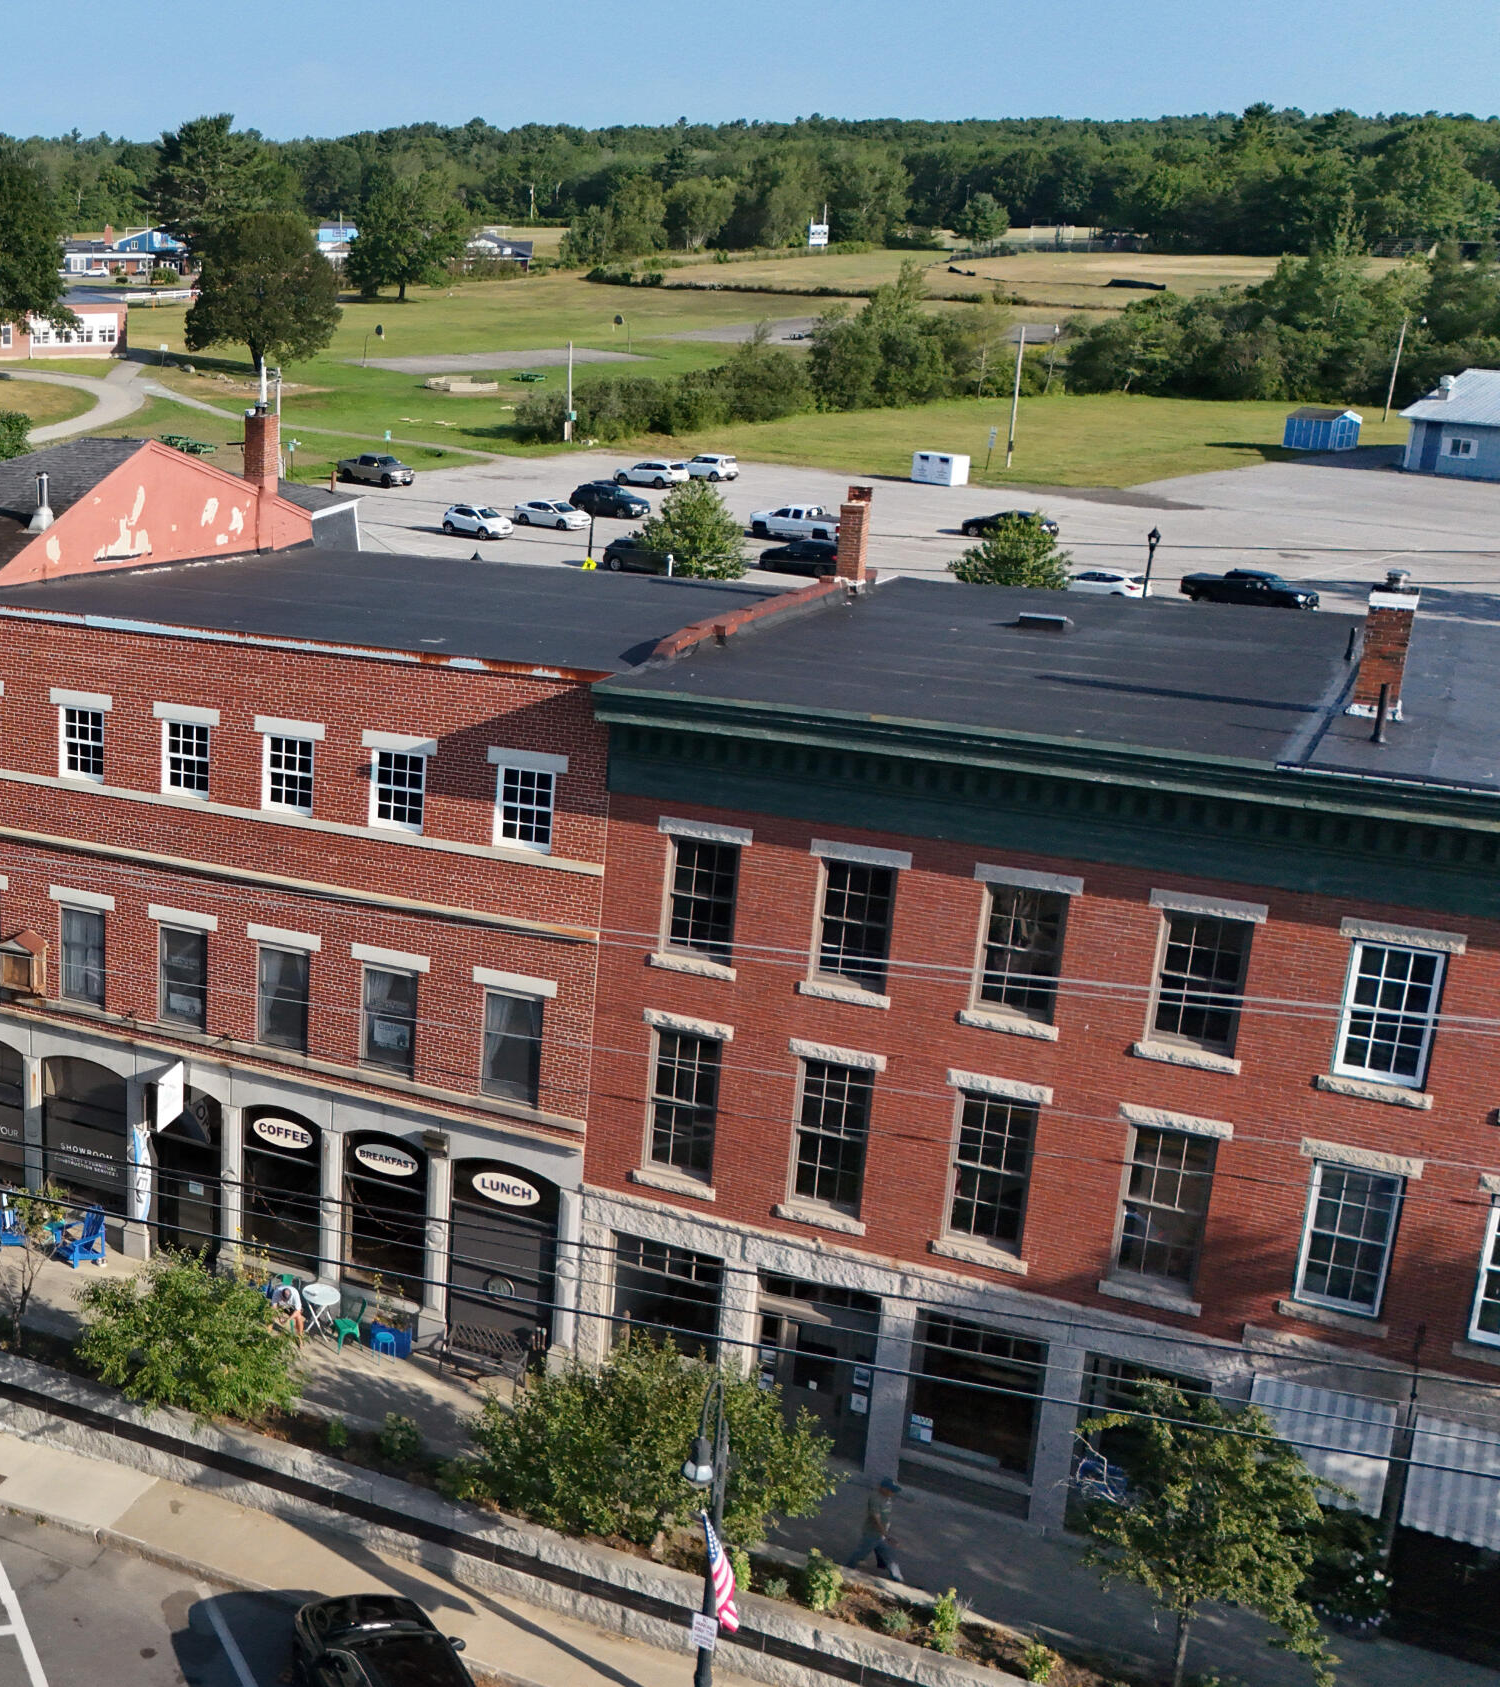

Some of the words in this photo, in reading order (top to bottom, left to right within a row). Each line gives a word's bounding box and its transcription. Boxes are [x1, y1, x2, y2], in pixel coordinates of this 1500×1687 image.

[258, 1122, 309, 1144] COFFEE
[359, 1148, 416, 1171] BREAKFAST
[481, 1177, 532, 1200] LUNCH
